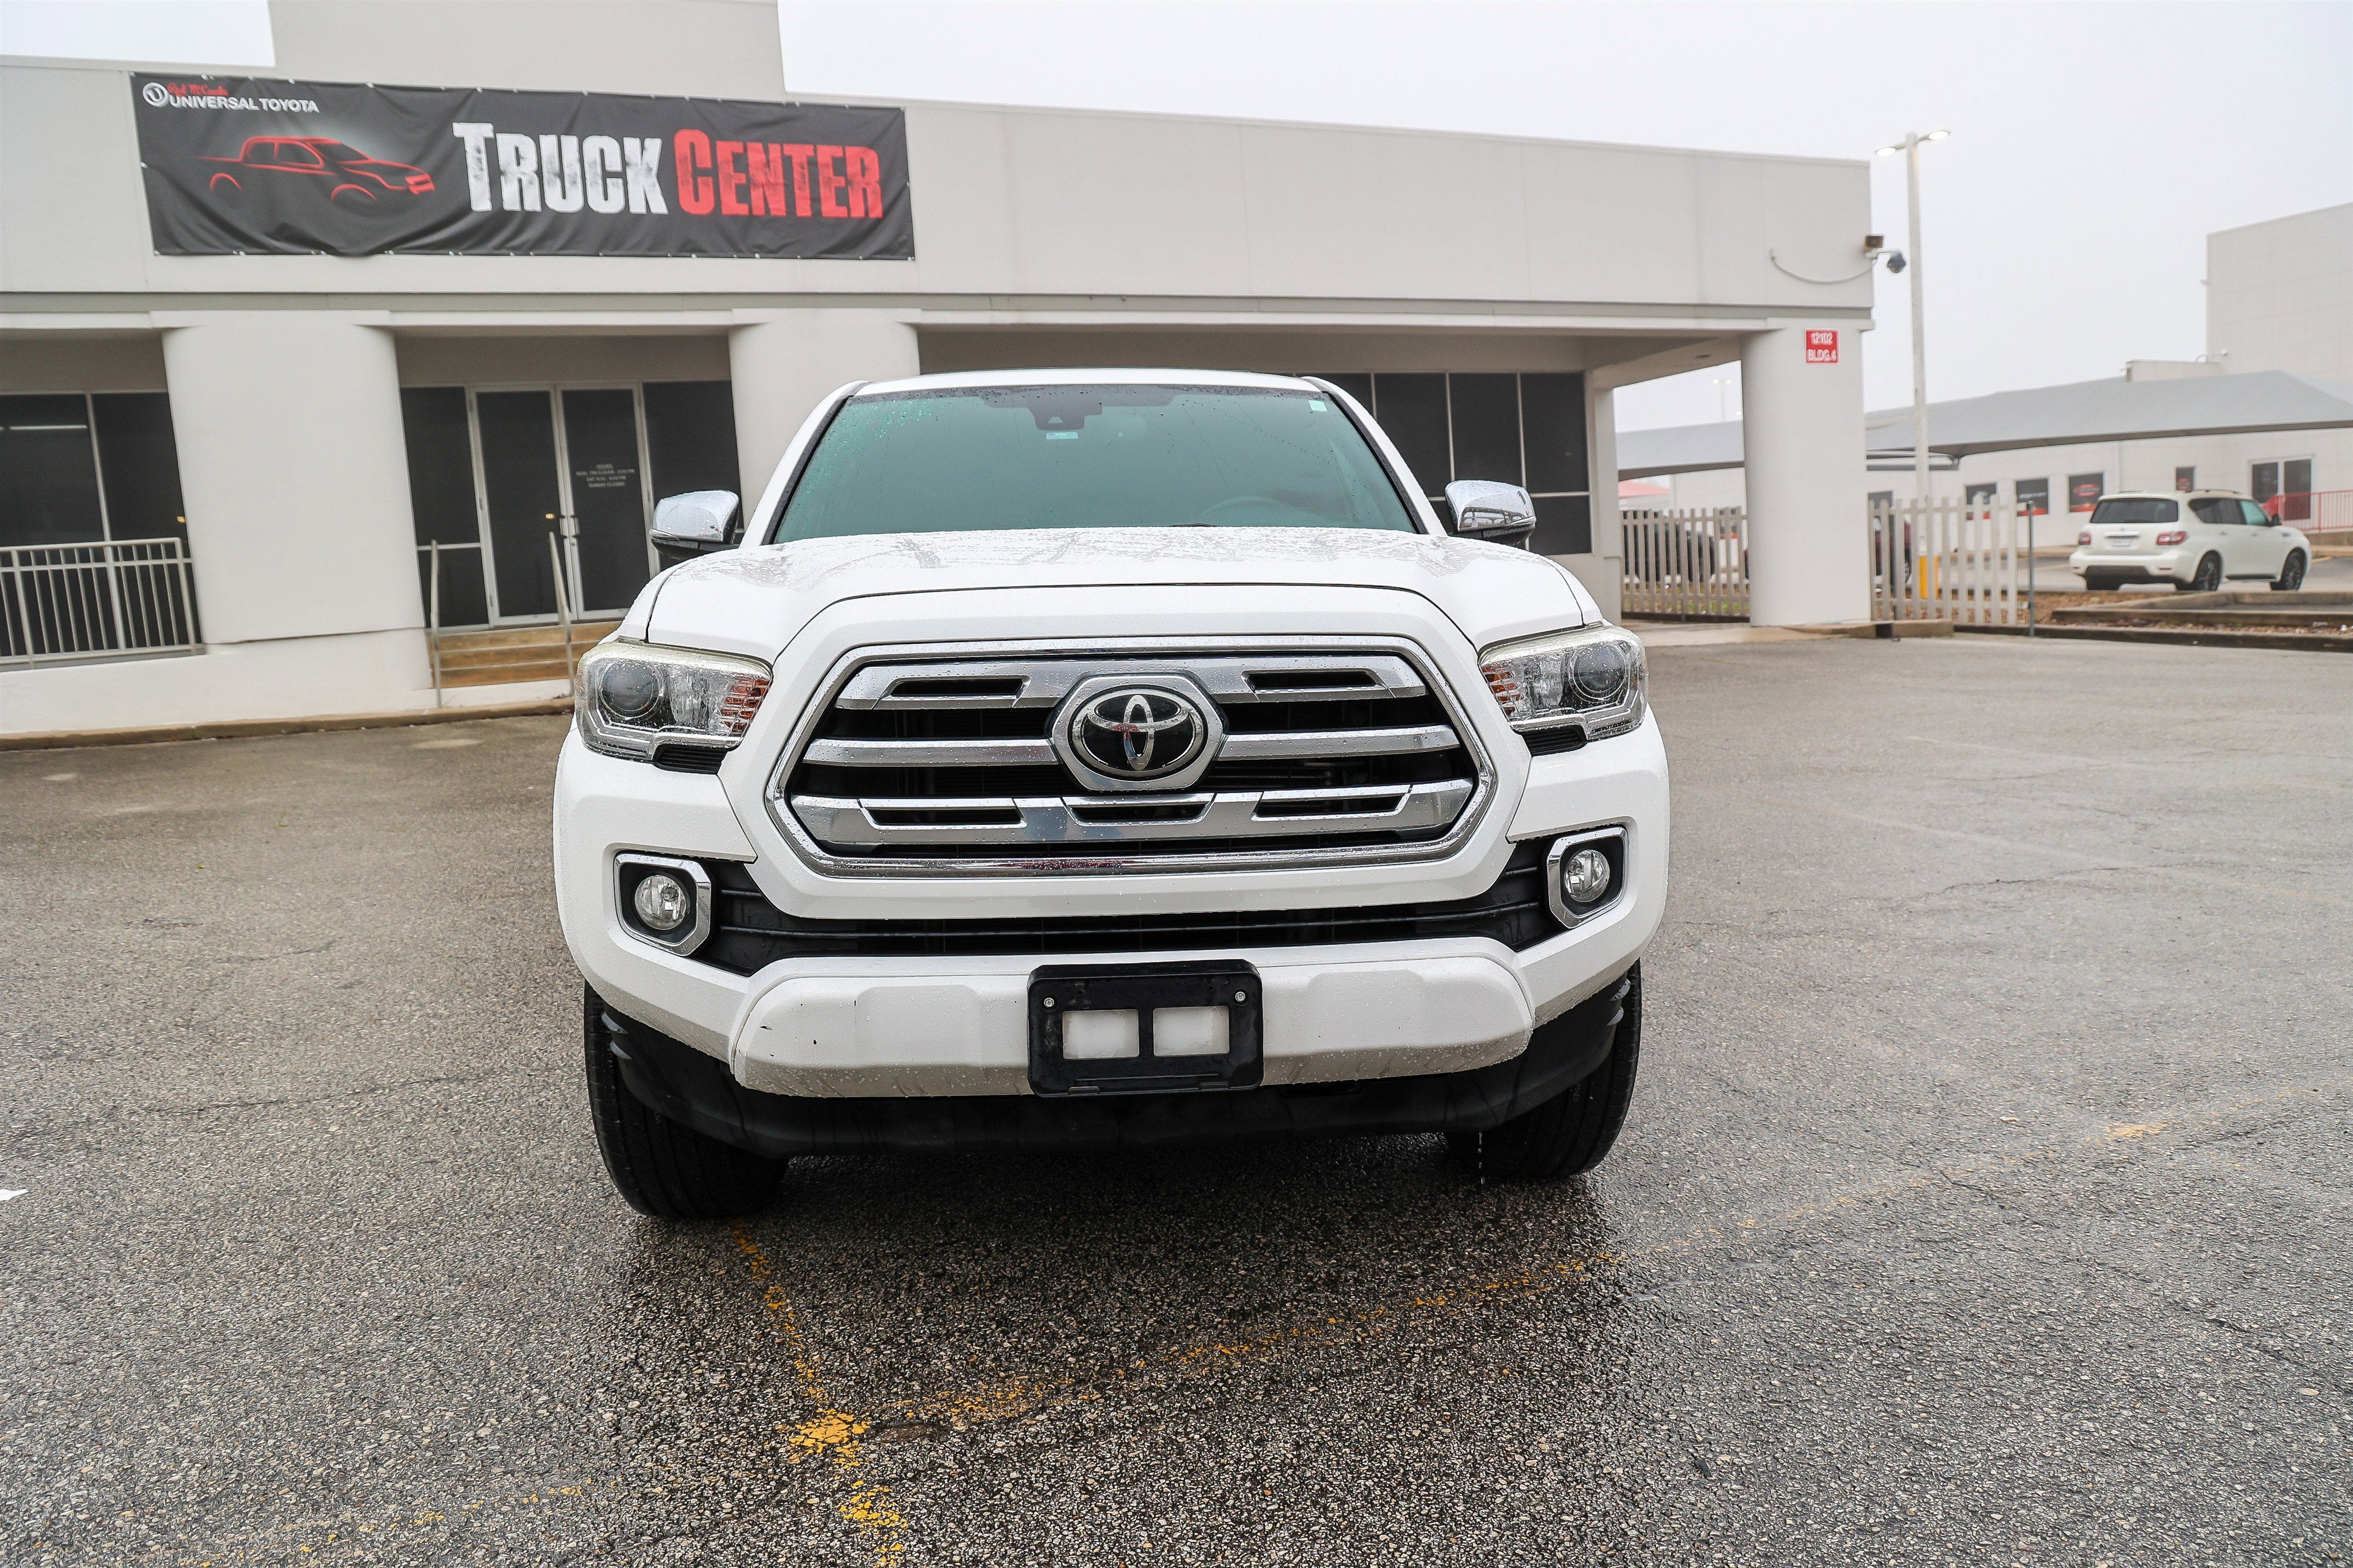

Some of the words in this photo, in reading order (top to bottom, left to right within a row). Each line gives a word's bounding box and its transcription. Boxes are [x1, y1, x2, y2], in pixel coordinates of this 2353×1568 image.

[169, 94, 260, 111] UNIVERSAL
[259, 98, 320, 113] TOYOTA
[452, 122, 669, 215] TRUCK
[673, 128, 884, 219] CENTER
[1810, 332, 1833, 345] 12102
[1807, 349, 1830, 362] BLDG
